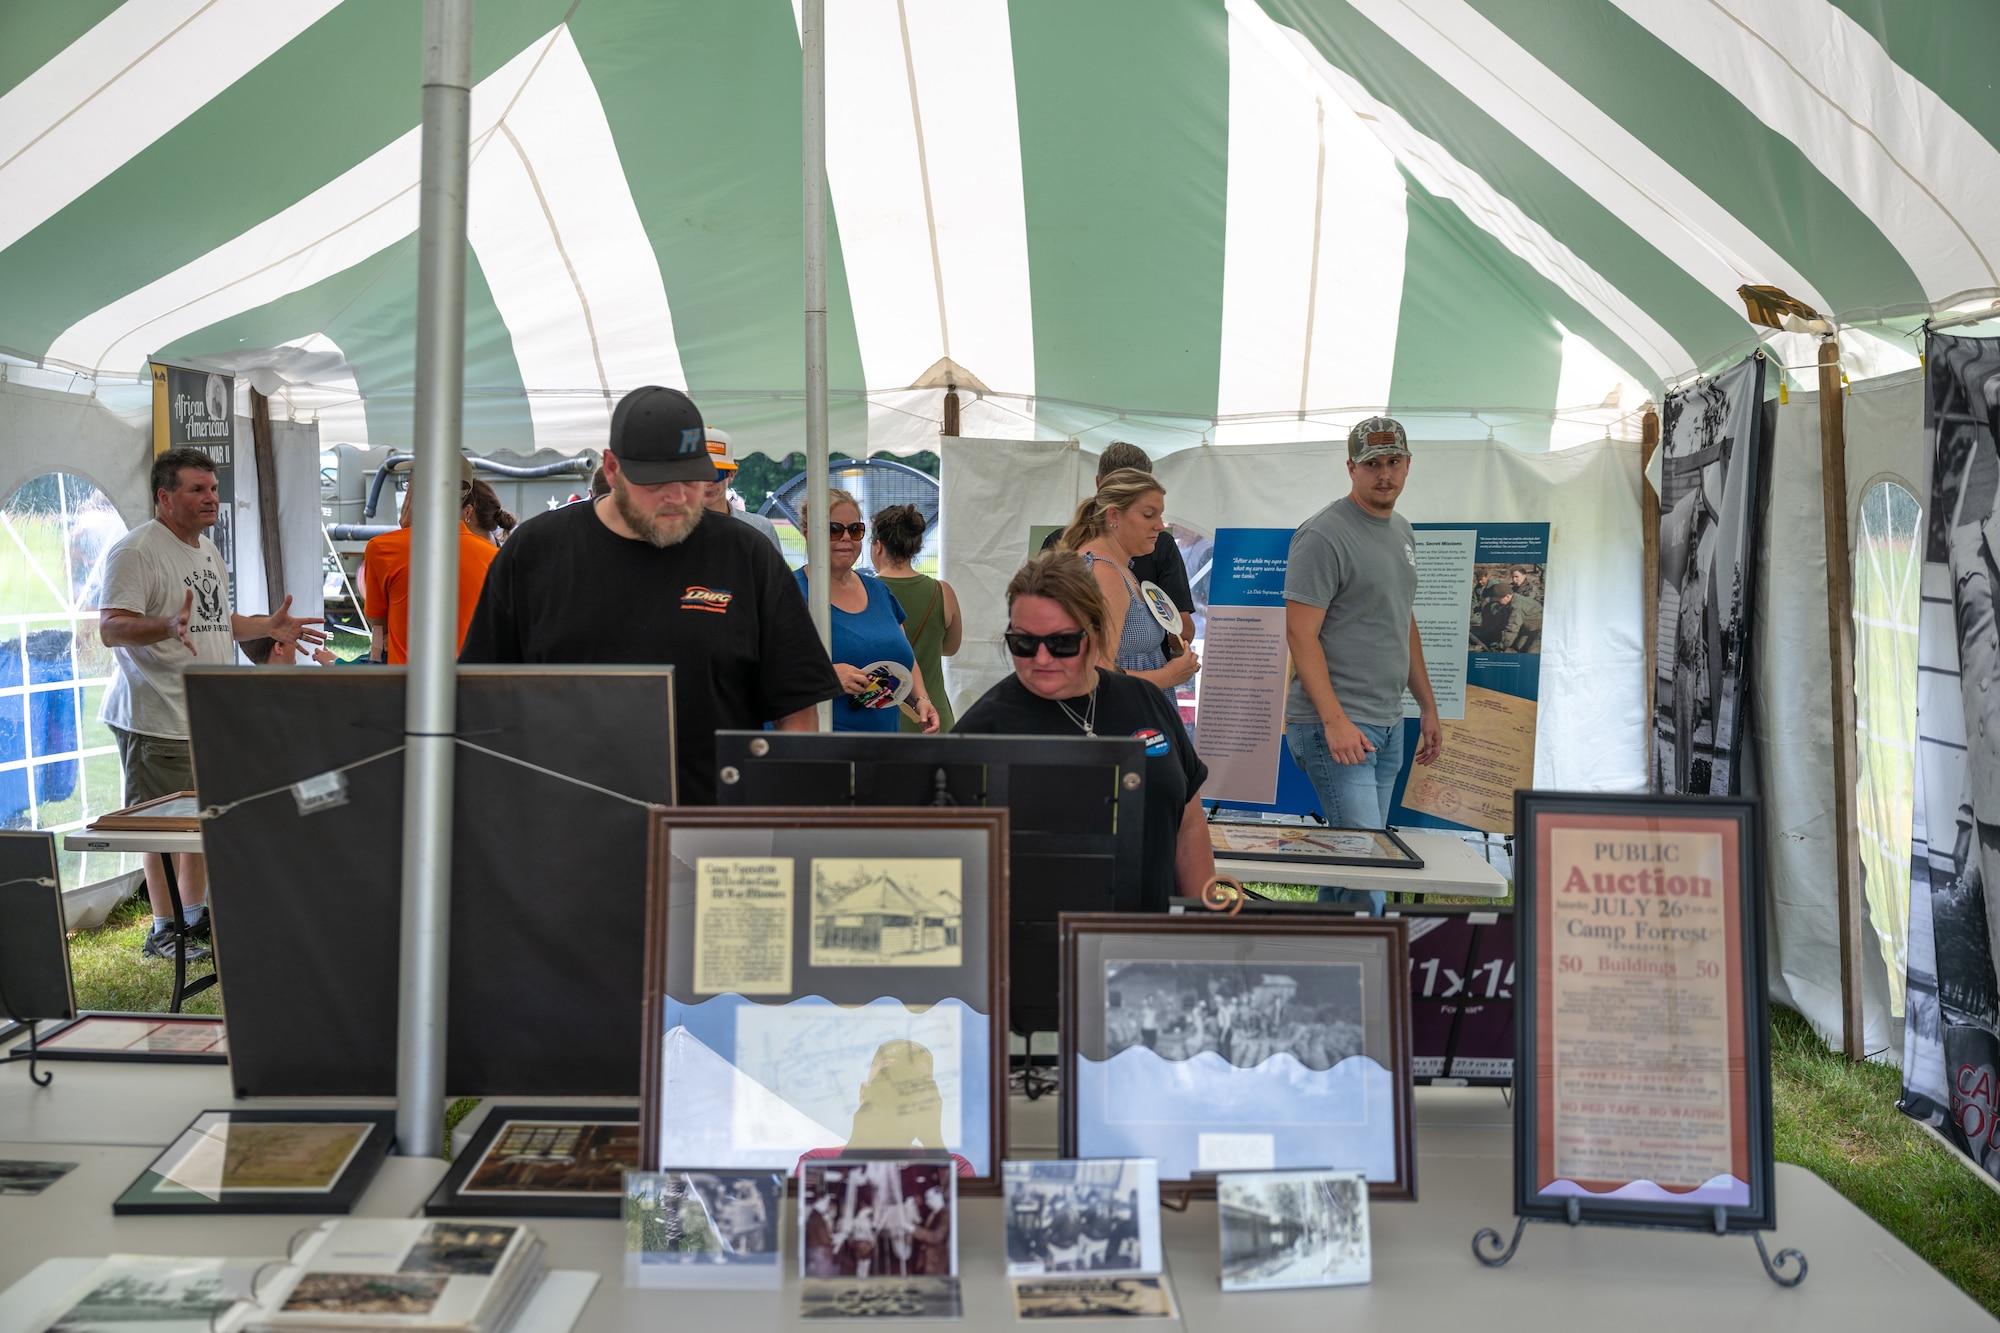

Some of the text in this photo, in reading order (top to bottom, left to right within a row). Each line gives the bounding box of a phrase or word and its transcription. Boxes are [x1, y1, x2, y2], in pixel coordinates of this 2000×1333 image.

[174, 393, 205, 424] African
[186, 415, 229, 440] Americans
[210, 445, 224, 463] WAR
[225, 446, 230, 463] II
[190, 624, 211, 633] CAMP
[1594, 842, 1680, 863] PUBLIC
[1562, 865, 1713, 898] Auction
[1592, 897, 1651, 917] JULY
[1657, 898, 1683, 918] 26
[1567, 918, 1709, 943] Camp Forrest
[1558, 955, 1720, 979] 50 Buildings 50
[1580, 1103, 1605, 1114] RED
[1608, 1104, 1640, 1116] TAPE
[1670, 1109, 1725, 1120] WAITING
